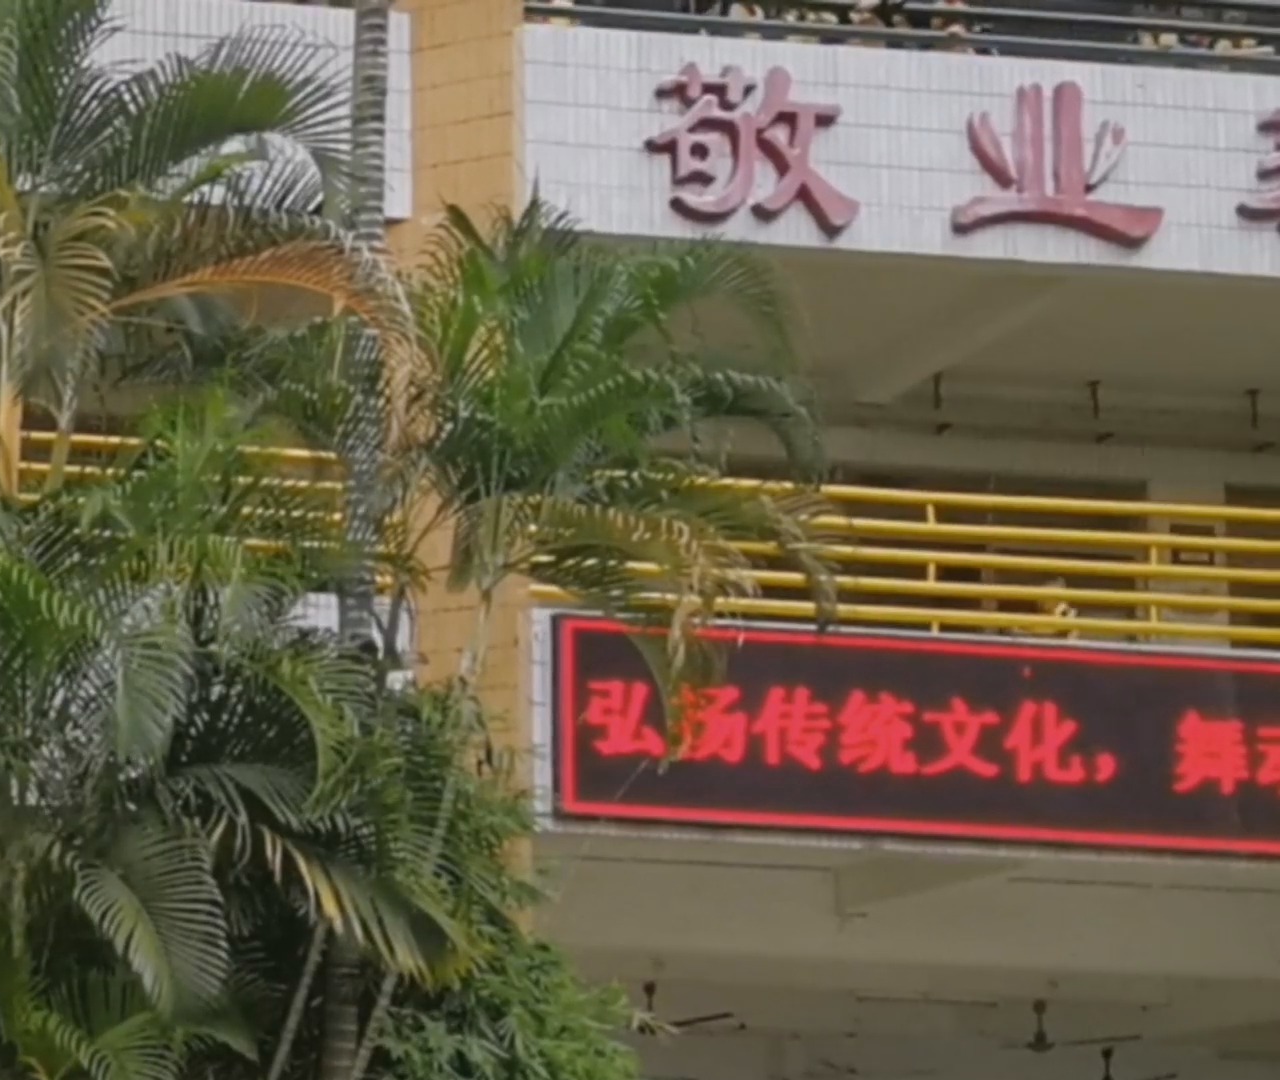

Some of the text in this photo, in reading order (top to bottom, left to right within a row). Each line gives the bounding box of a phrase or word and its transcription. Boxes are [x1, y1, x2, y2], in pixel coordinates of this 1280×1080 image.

[645, 62, 1280, 248] 敬业
[586, 680, 1280, 796] 弘扬传统文化，舞
